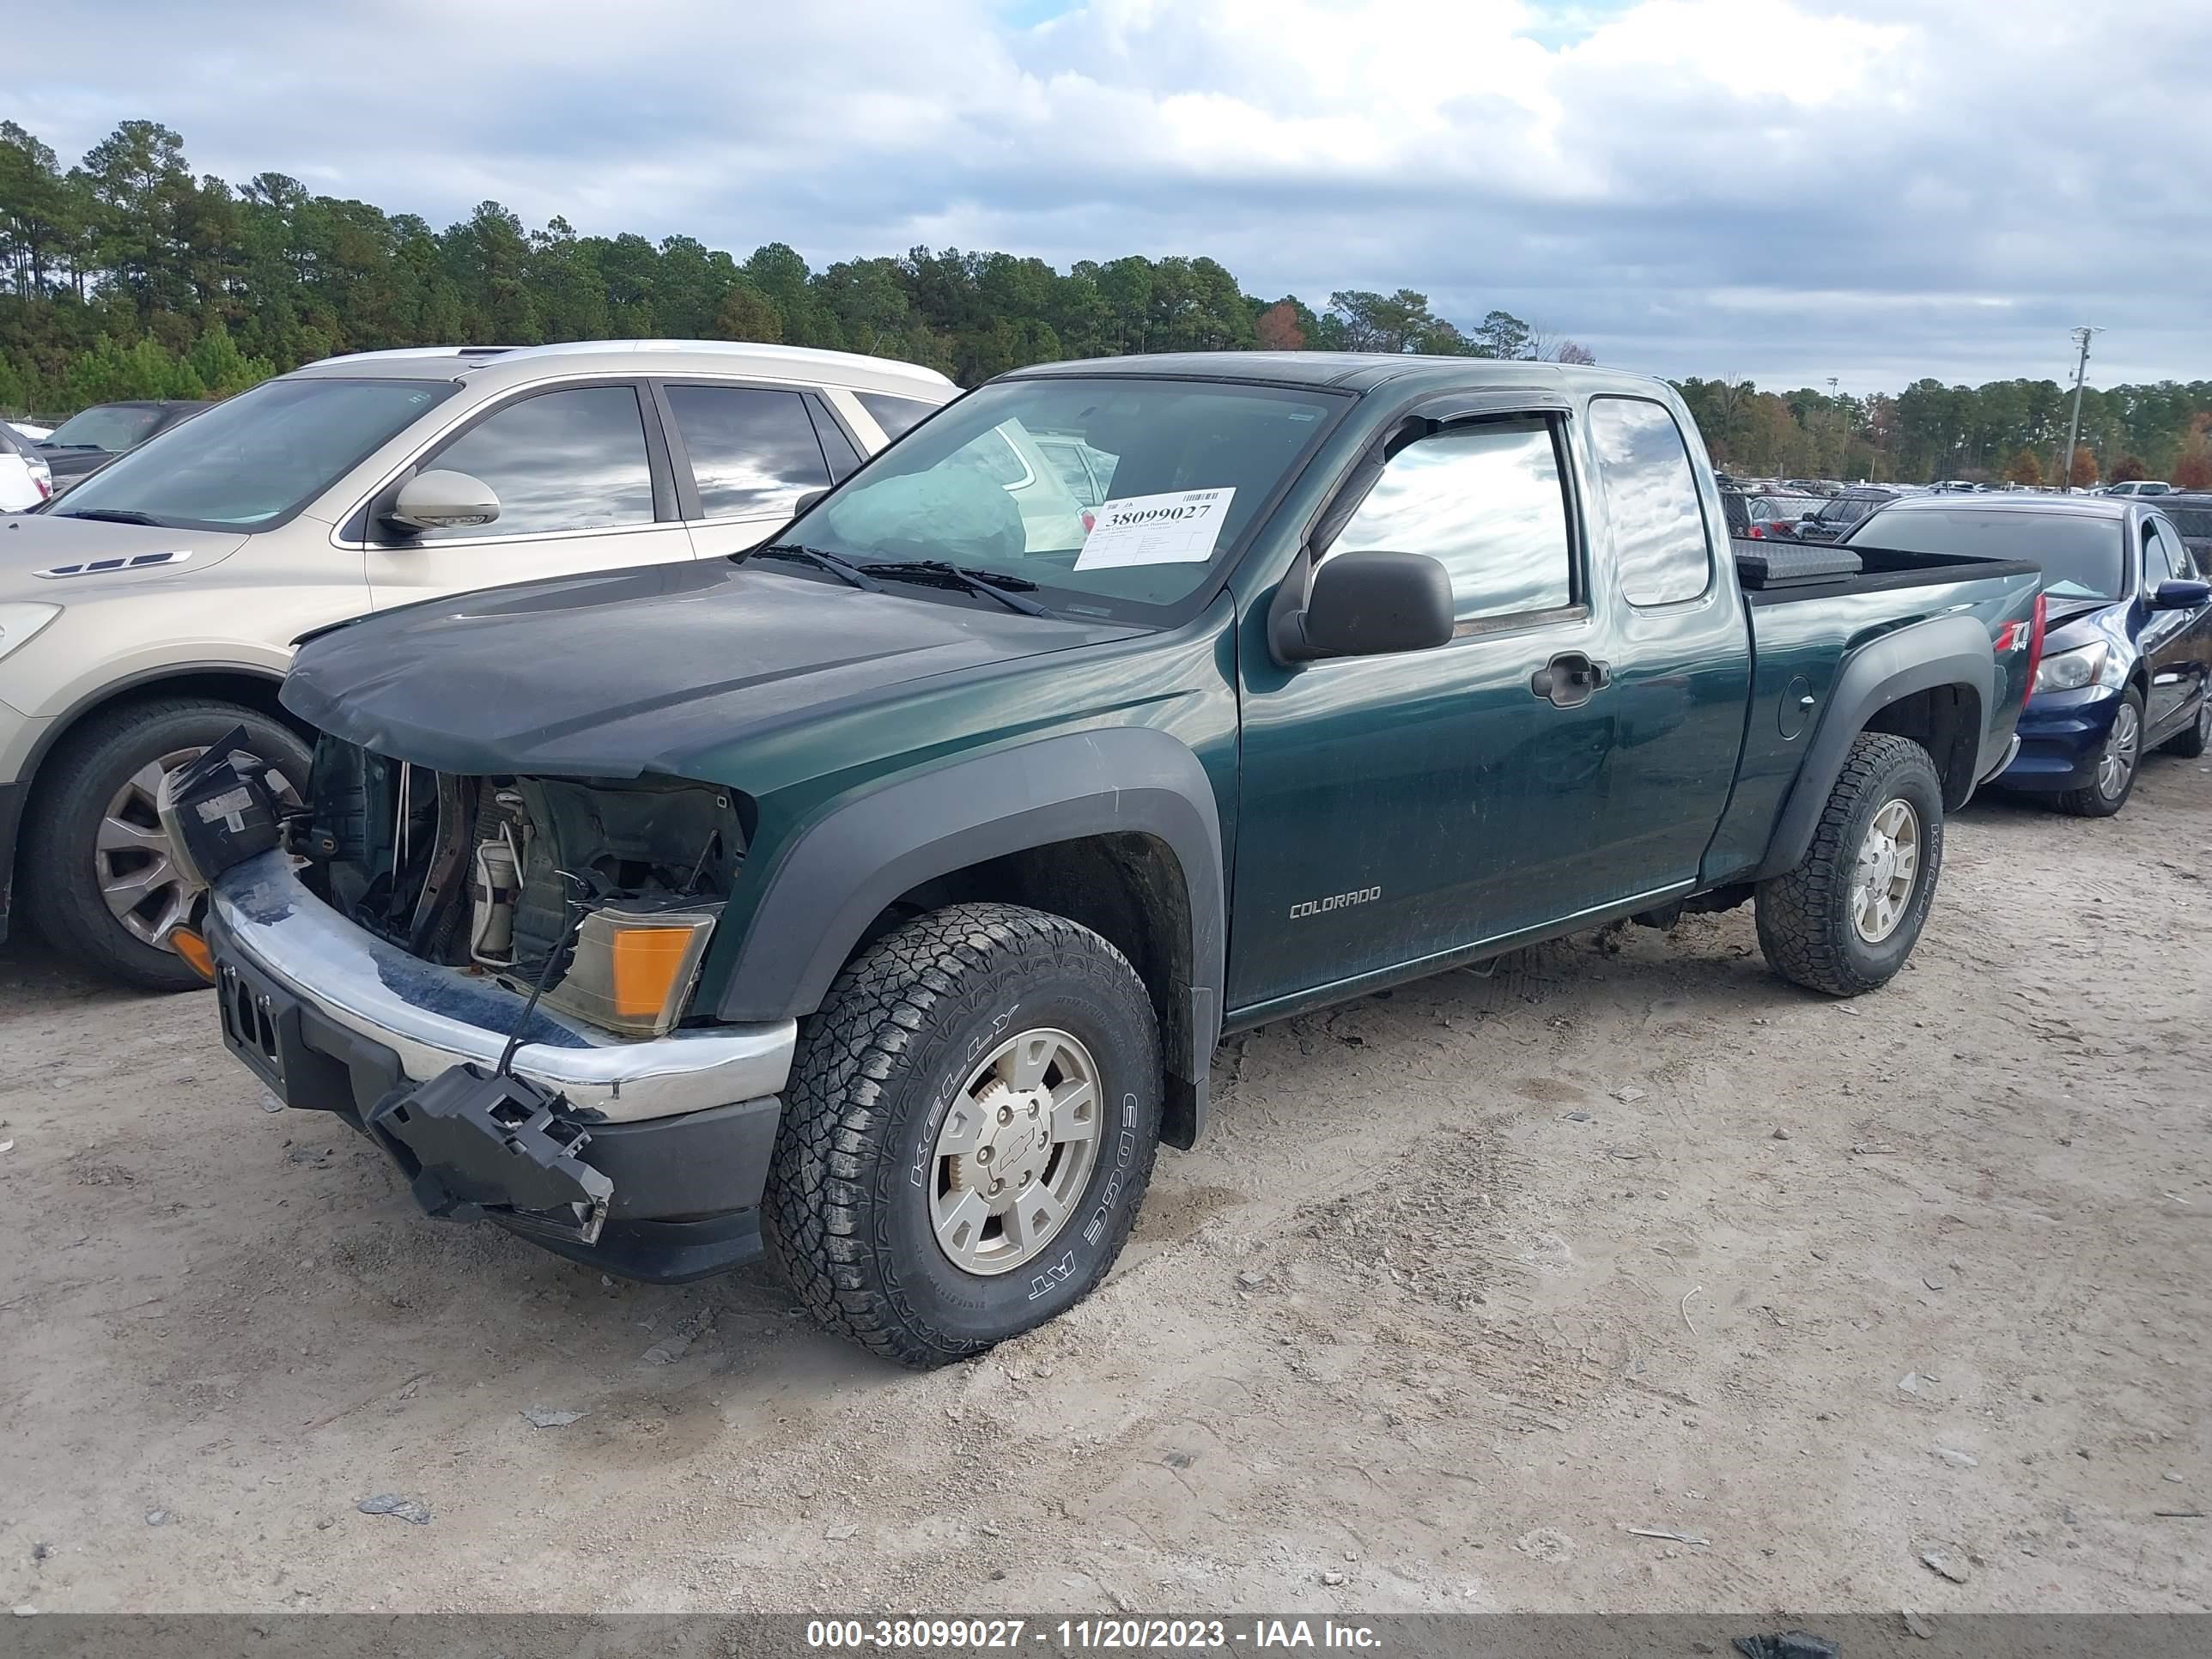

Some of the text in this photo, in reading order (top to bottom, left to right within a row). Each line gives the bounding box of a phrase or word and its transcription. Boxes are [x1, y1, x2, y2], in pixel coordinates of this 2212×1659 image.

[1105, 504, 1212, 527] 38099027
[1289, 885, 1382, 920] COLORADO
[909, 1003, 1021, 1188] KELLY
[1028, 1092, 1138, 1301] EDGE AT
